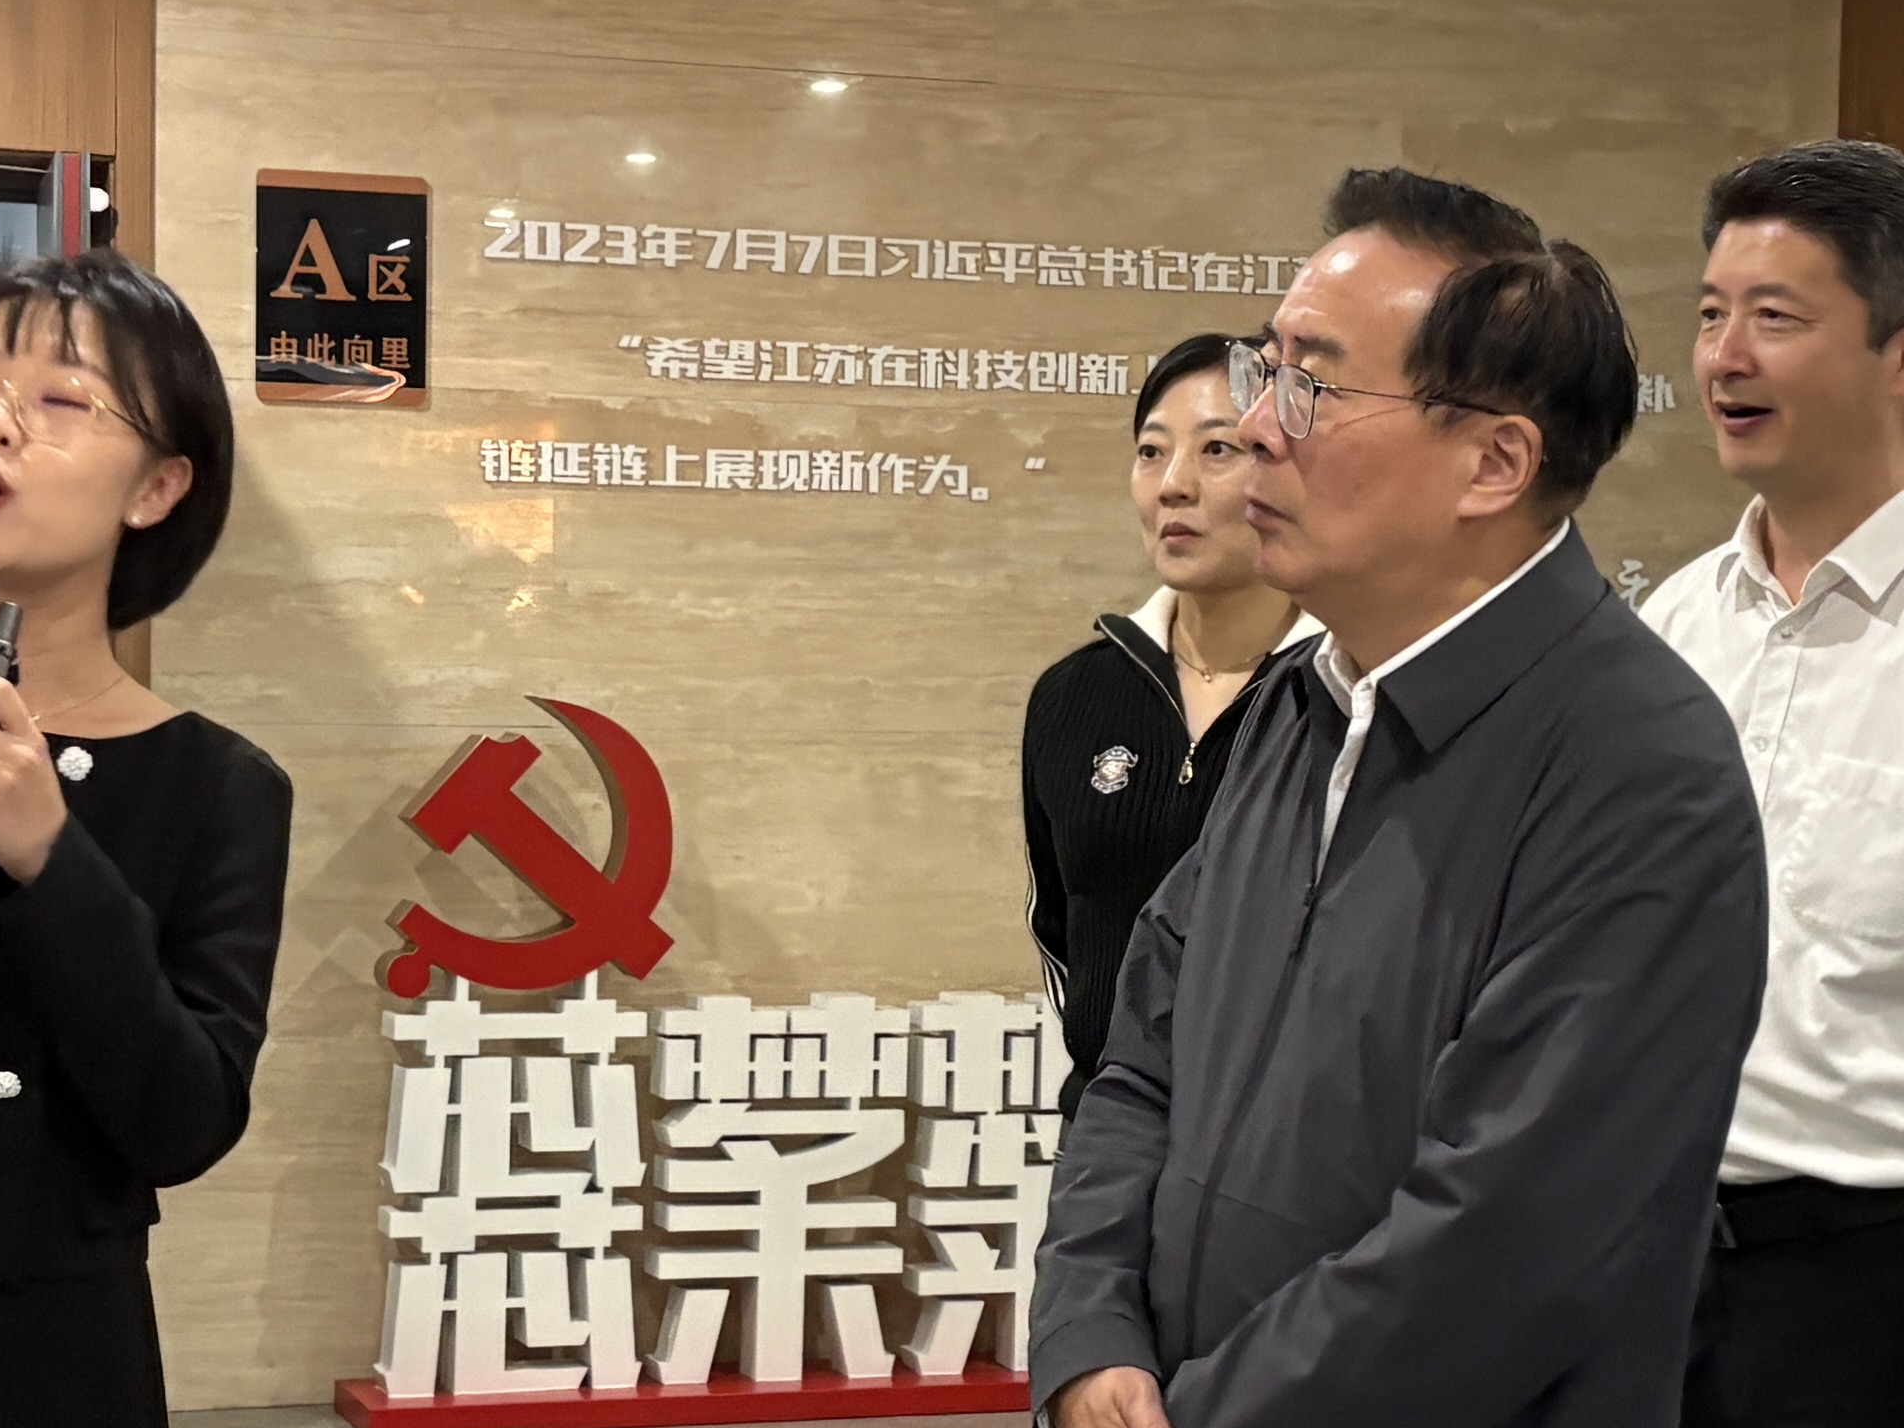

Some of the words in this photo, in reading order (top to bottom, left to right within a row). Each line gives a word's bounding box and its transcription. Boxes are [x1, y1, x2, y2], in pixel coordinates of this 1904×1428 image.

[269, 218, 413, 302] A区
[483, 218, 1308, 296] 2023年7月7日习近平总书记在江
[269, 330, 411, 369] 由此向里
